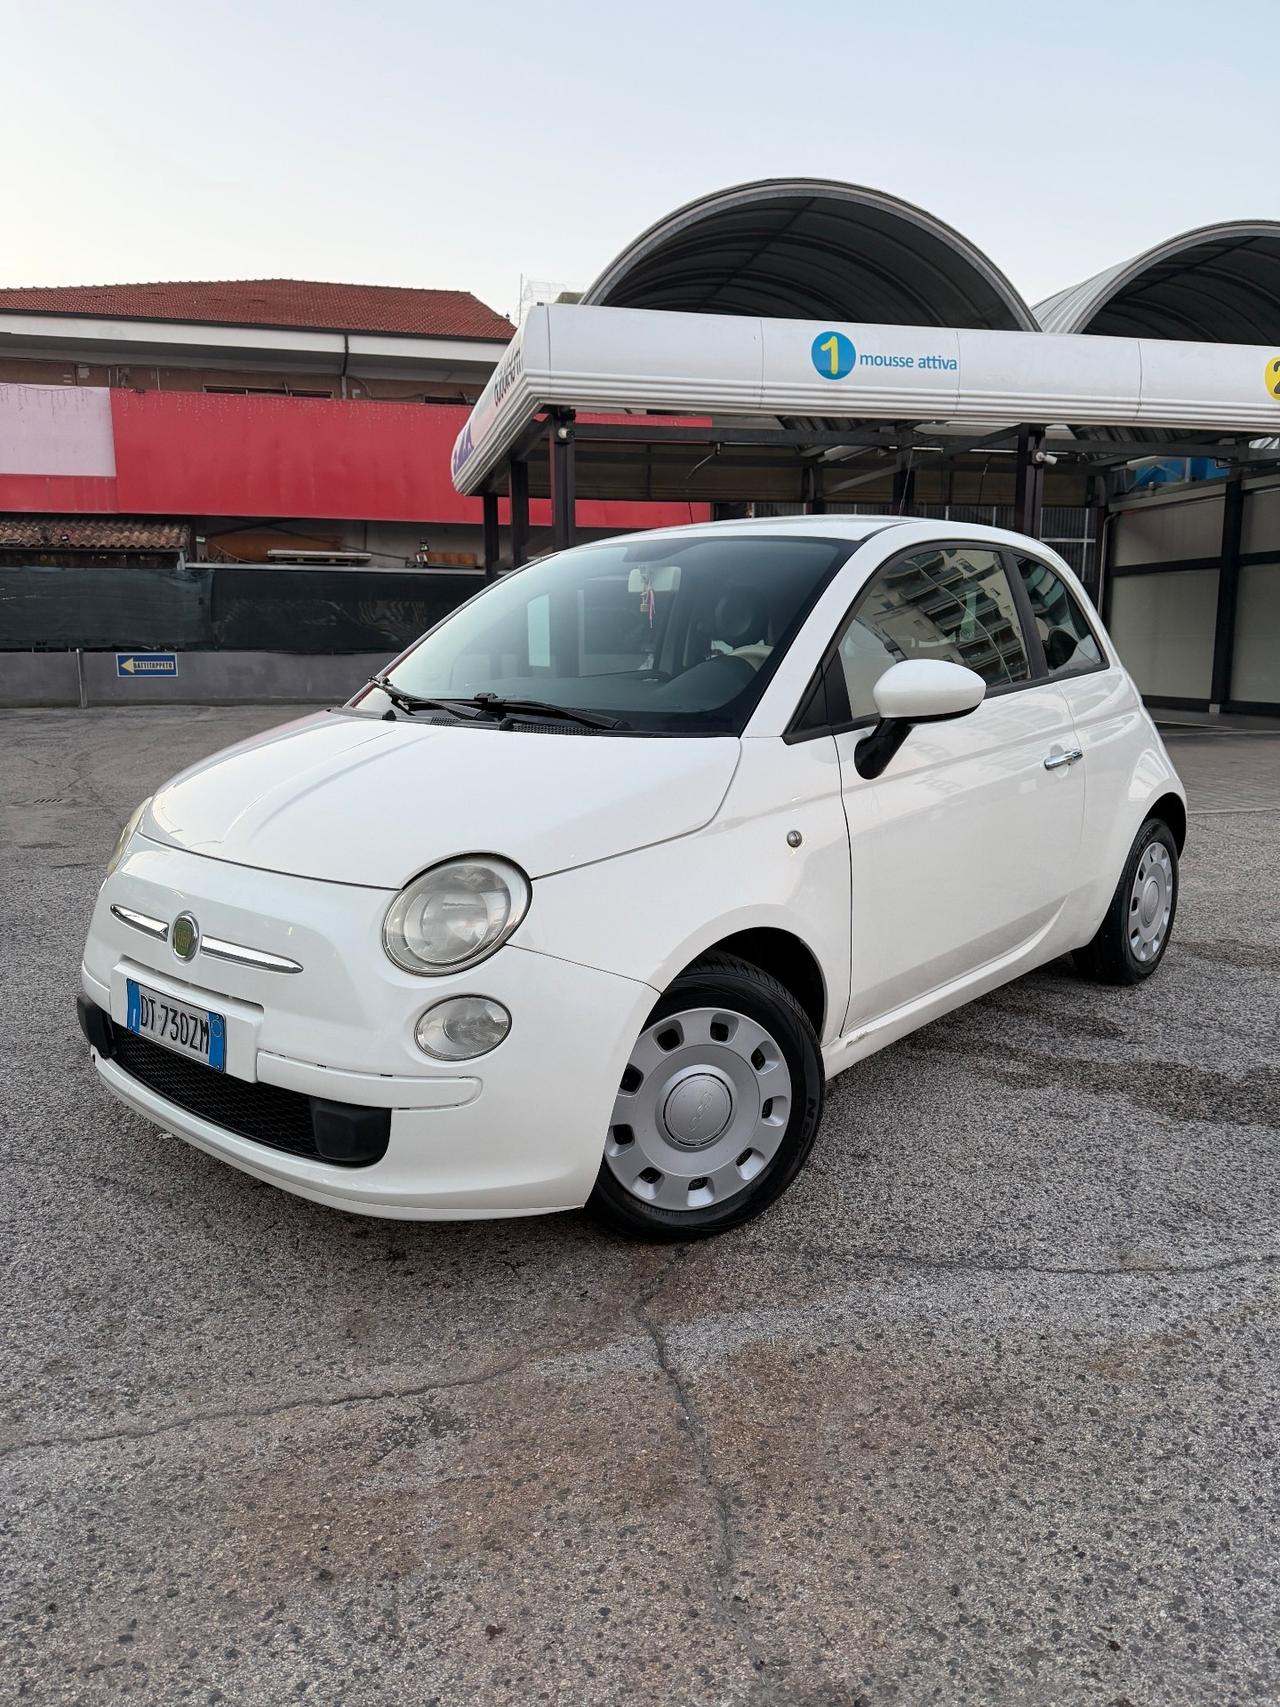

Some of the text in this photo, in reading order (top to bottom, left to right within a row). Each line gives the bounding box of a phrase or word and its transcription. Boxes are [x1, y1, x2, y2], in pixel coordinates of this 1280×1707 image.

[820, 335, 958, 375] 1 mousse attiva
